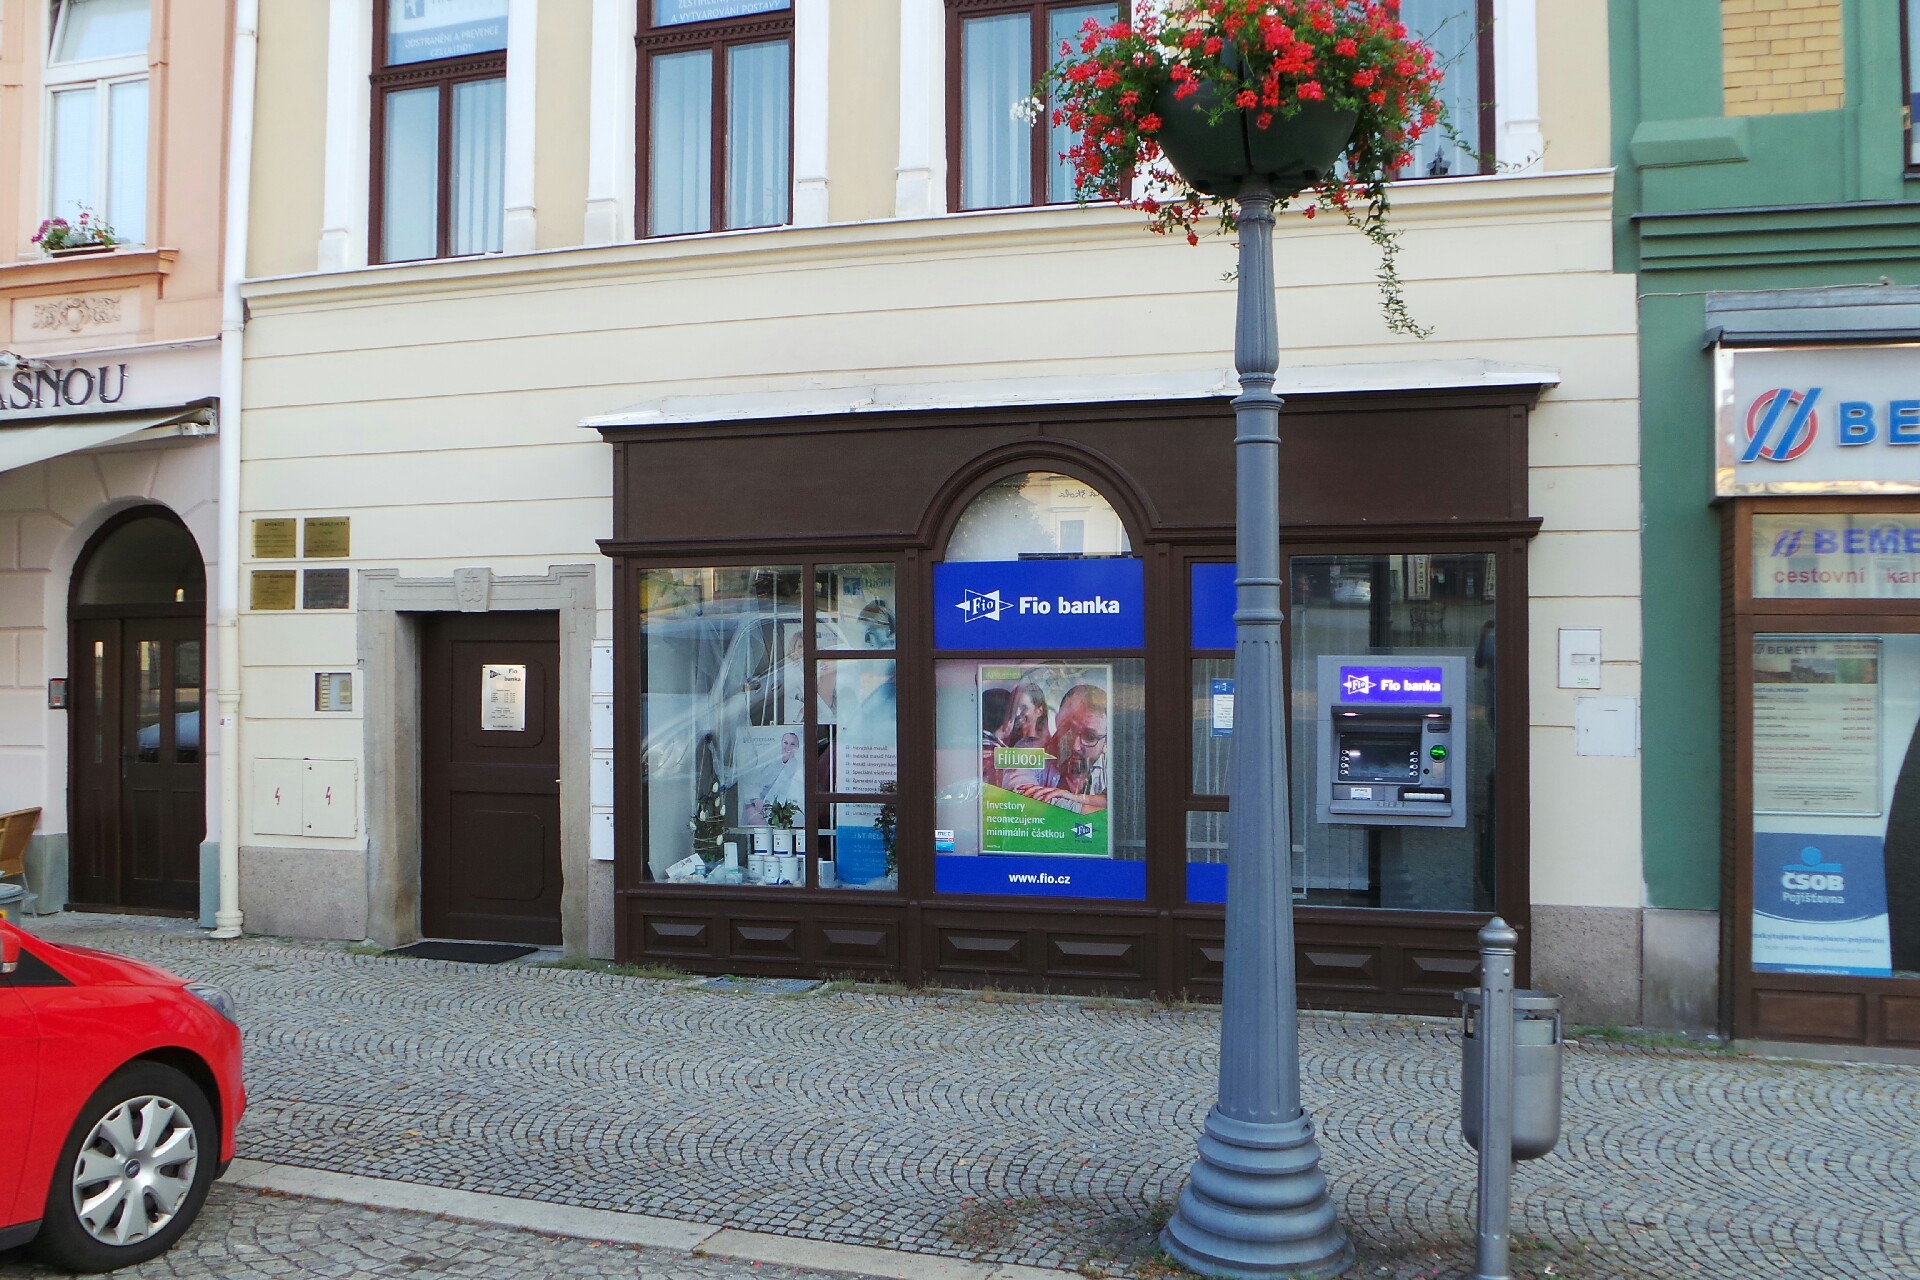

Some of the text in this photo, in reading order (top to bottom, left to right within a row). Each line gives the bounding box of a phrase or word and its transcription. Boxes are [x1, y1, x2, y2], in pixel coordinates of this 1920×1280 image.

[670, 0, 780, 24] A VYTVAROVÁNÍ POSTAVY
[461, 25, 499, 40] PREVENCE
[972, 596, 994, 615] Fio
[1019, 595, 1120, 614] Fio banka
[1381, 679, 1441, 691] Fio banka
[986, 800, 1026, 812] Investory
[986, 815, 1046, 825] neomezujeme
[986, 828, 1065, 839] minimální částkou
[1008, 872, 1071, 884] www.fio.cz
[1781, 871, 1845, 891] ČSOB
[1782, 891, 1845, 905] Pojišťovna
